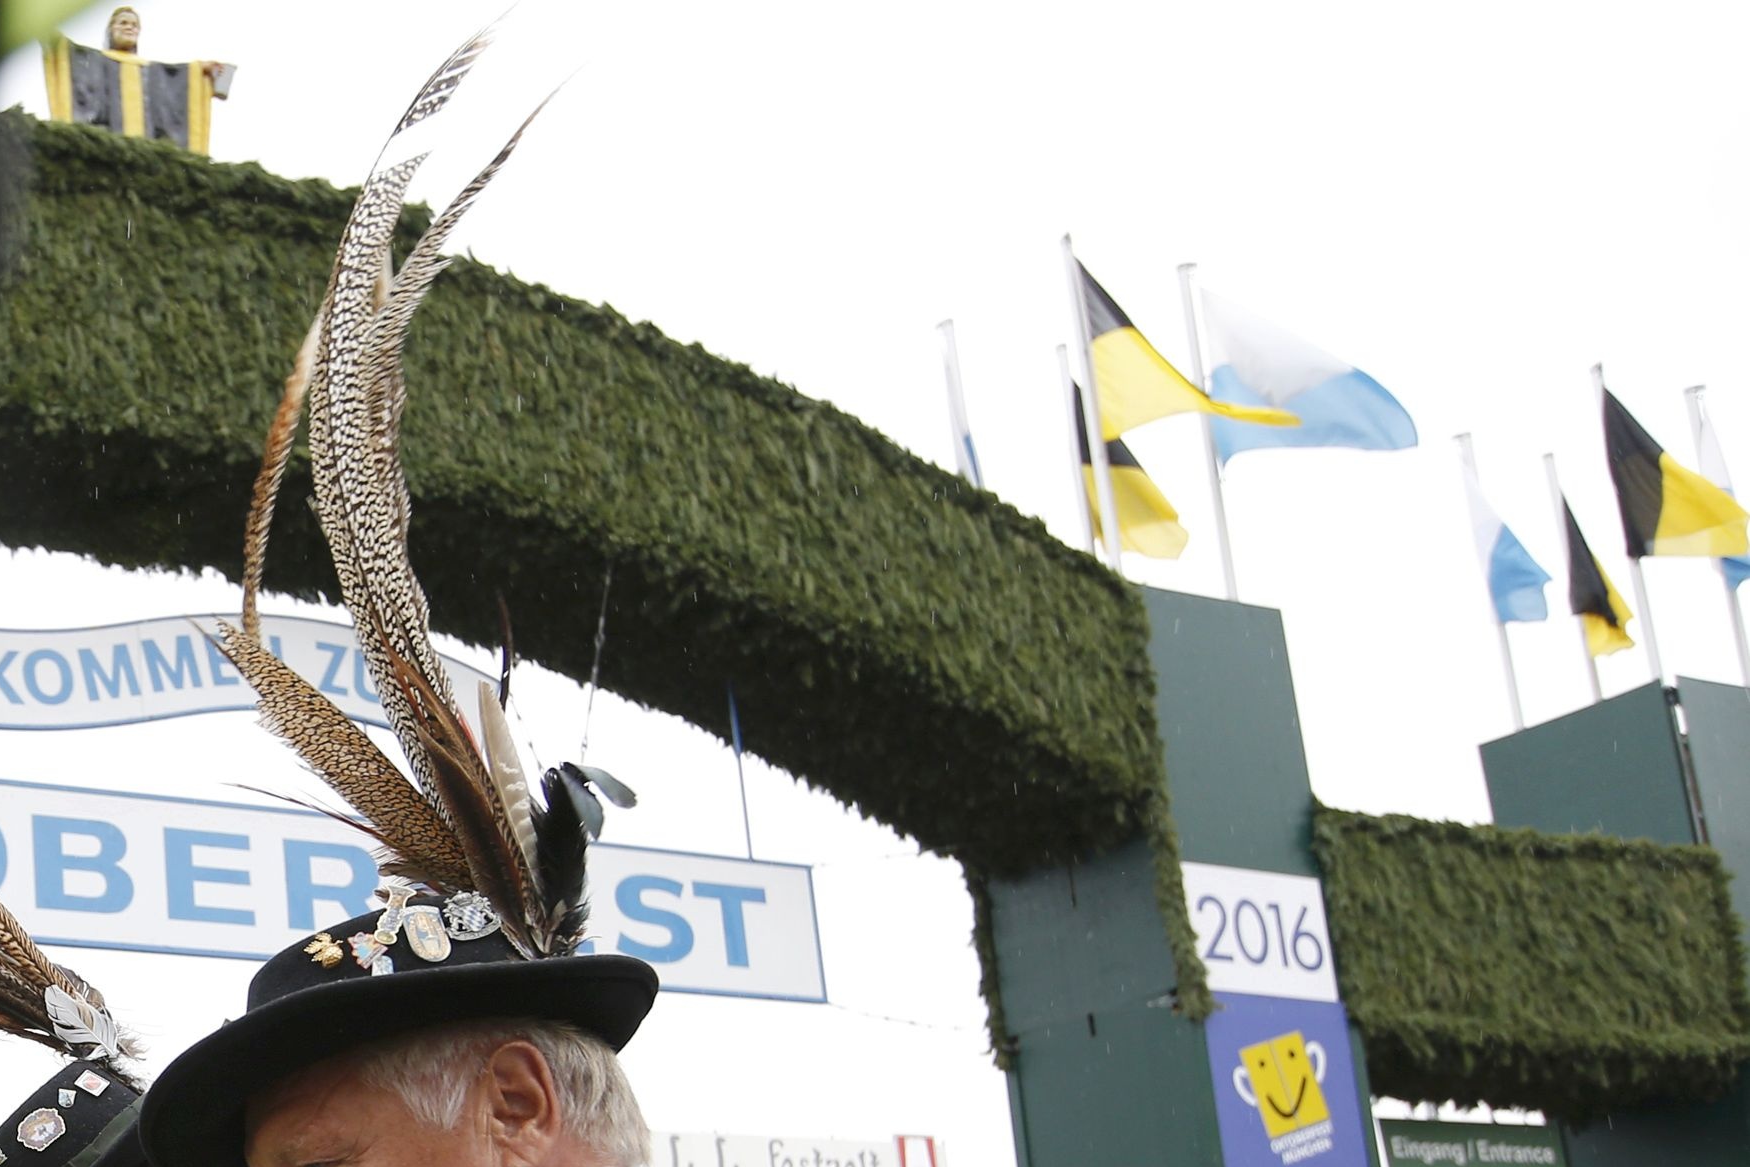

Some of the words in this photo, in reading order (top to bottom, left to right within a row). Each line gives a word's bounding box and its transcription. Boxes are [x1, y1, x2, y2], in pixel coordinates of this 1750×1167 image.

[1197, 895, 1323, 971] 2016
[1390, 1135, 1466, 1166] Eingang
[1476, 1139, 1555, 1164] Entrance
